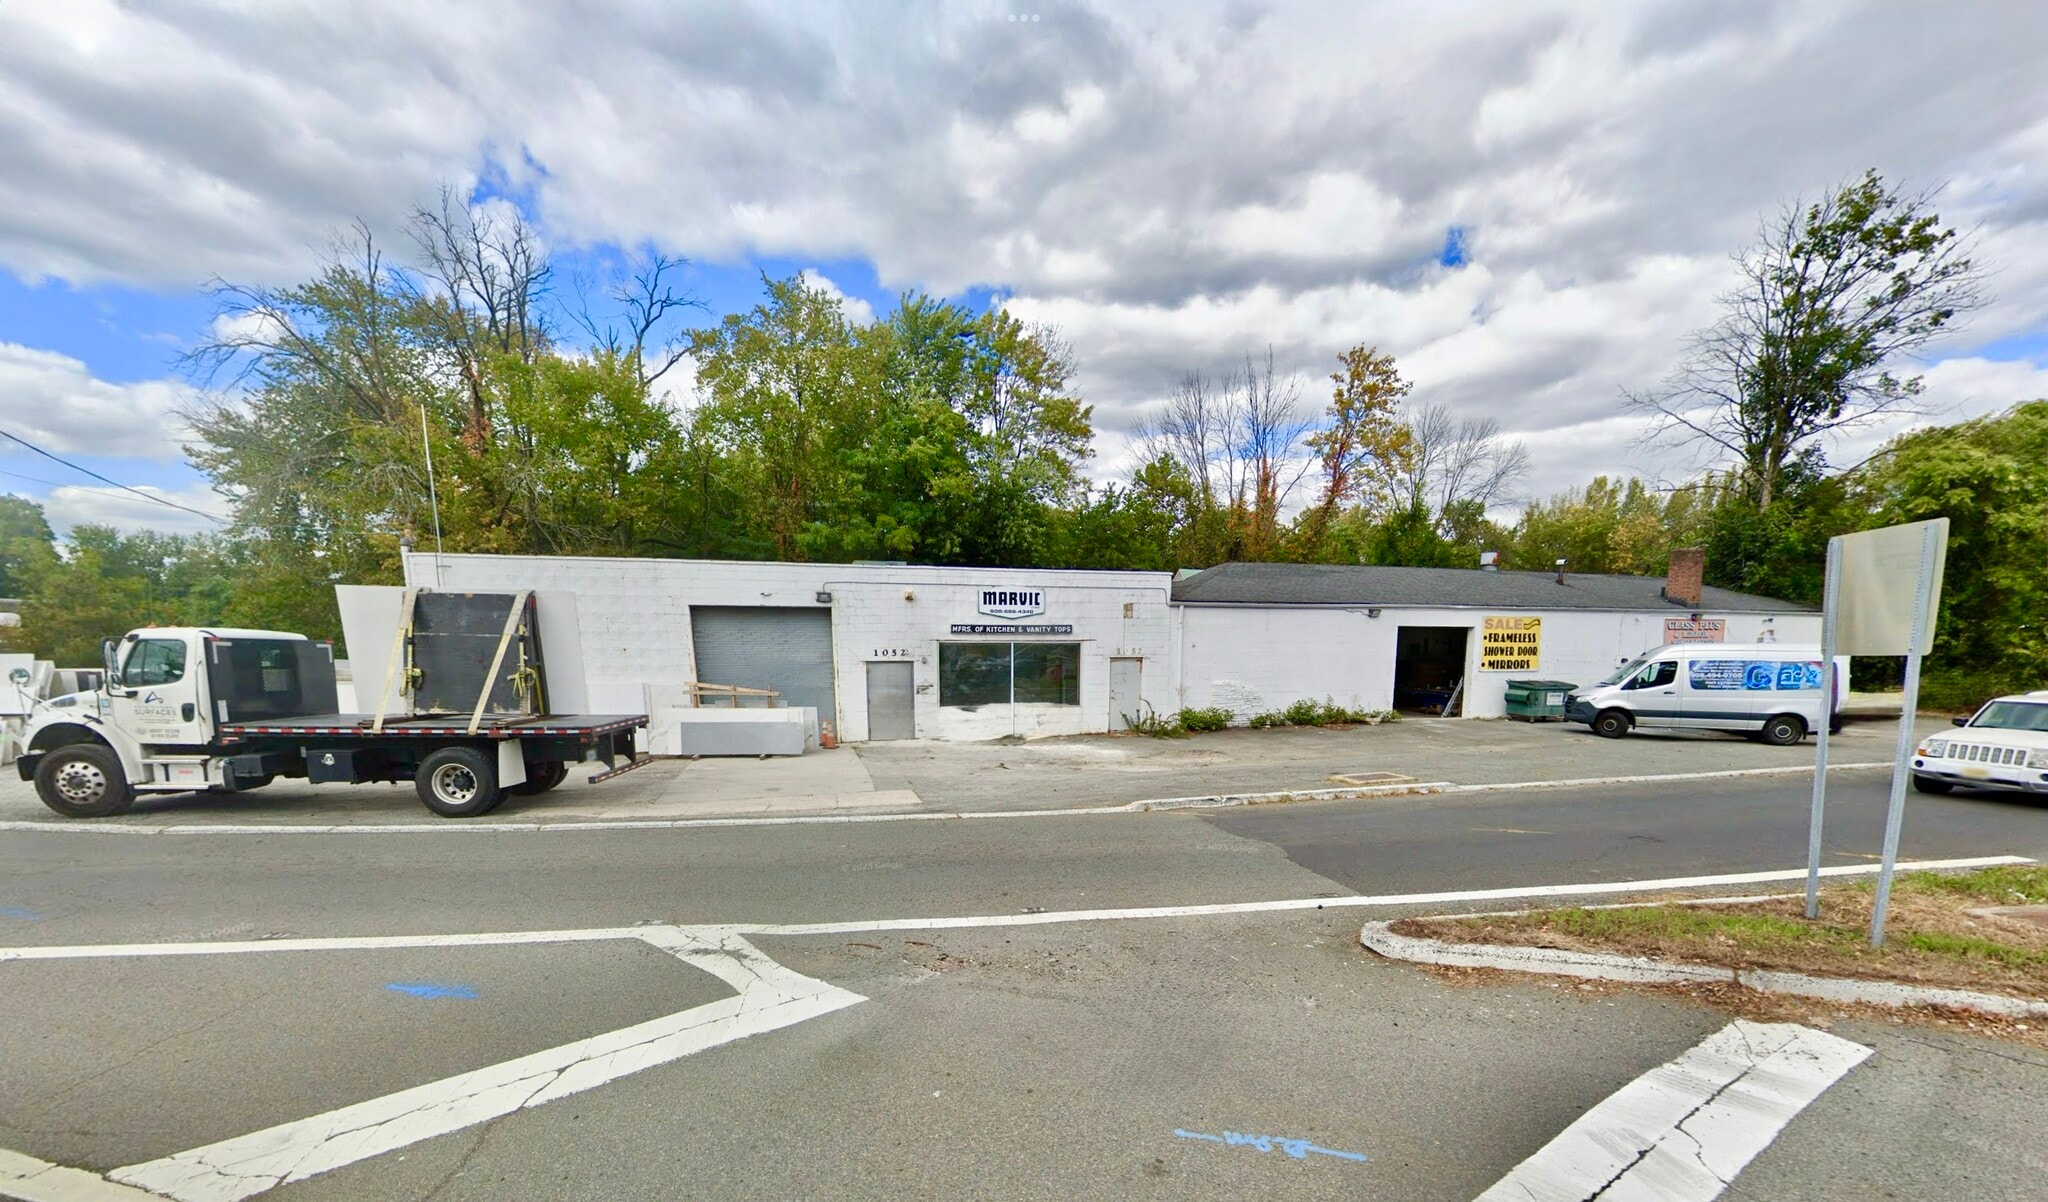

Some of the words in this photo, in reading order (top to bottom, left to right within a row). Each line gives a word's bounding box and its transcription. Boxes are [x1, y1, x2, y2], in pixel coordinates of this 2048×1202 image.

[983, 591, 1040, 606] MARVIC
[952, 625, 973, 633] MFRS.
[974, 625, 984, 633] OF
[1484, 618, 1522, 630] SALE
[1488, 633, 1537, 643] FRAMELESS
[873, 649, 906, 657] 1052
[1484, 646, 1515, 656] SHOWER
[1517, 646, 1538, 656] DOOR
[1488, 659, 1531, 670] MIRRORS
